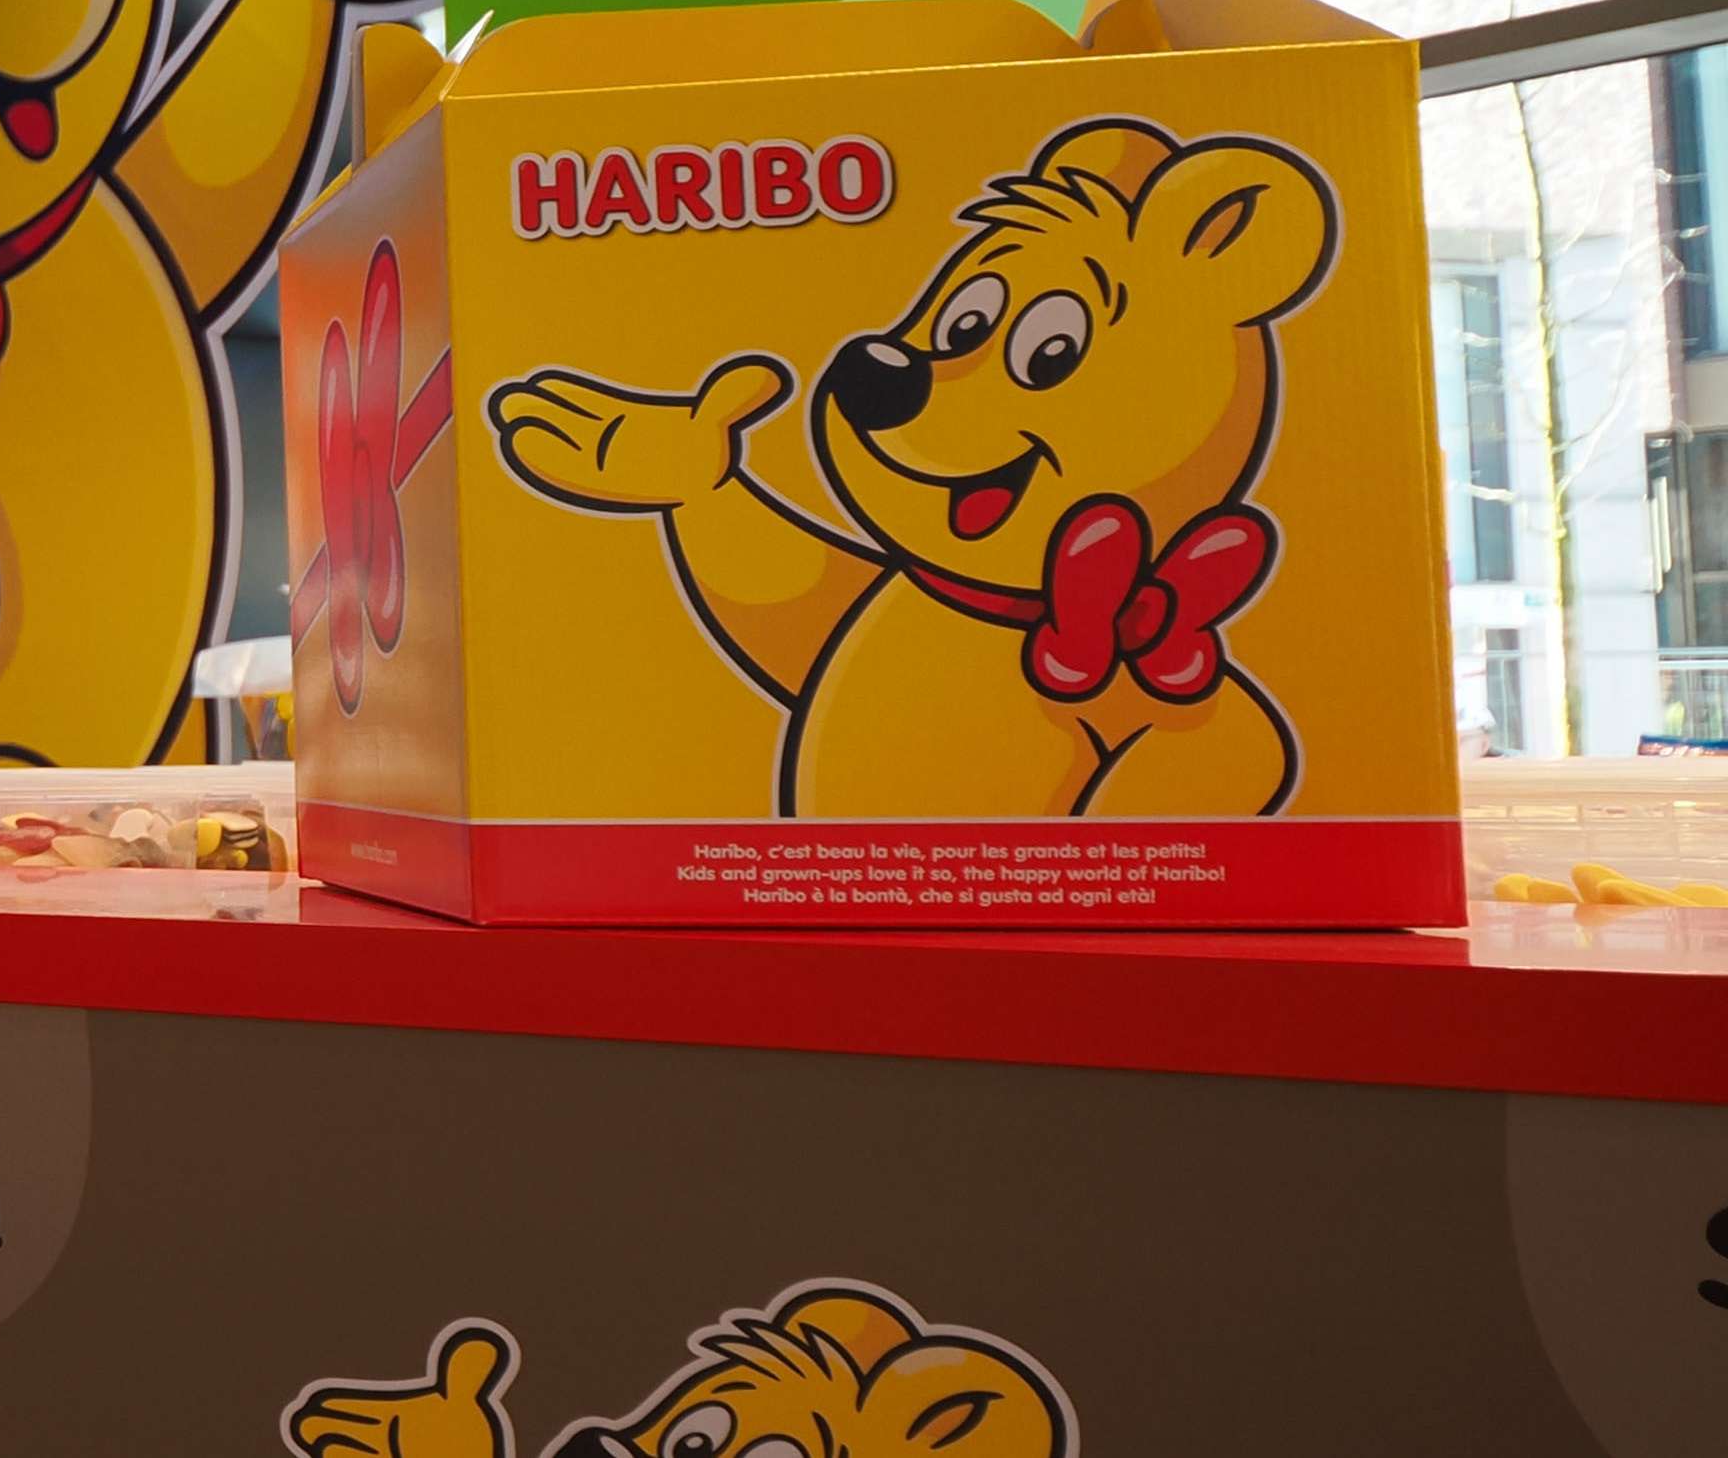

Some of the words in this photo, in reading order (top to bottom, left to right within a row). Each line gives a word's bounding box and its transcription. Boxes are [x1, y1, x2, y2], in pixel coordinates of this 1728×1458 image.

[516, 140, 886, 233] HARIBO
[694, 844, 762, 861] Haribo,
[817, 844, 865, 859] beau
[871, 843, 888, 859] la
[893, 844, 925, 861] vie,
[932, 847, 976, 862] pour
[982, 843, 1008, 859] les
[1015, 843, 1081, 862] grands
[1087, 844, 1106, 859] et
[1112, 843, 1139, 859] les
[1146, 843, 1206, 862] petits!
[677, 866, 716, 881] Kids
[721, 866, 757, 881] and
[762, 868, 863, 884] grown-ups
[868, 866, 907, 881] love
[912, 866, 925, 881] it
[930, 869, 957, 883] so,
[964, 866, 994, 881] the
[1000, 866, 1062, 884] happy
[1067, 866, 1121, 881] world
[1127, 866, 1148, 881] of
[1153, 866, 1225, 882] Haribo!
[744, 888, 806, 903] Haribo
[812, 888, 824, 903] è
[830, 888, 847, 903] la
[852, 888, 913, 906] bontà,
[919, 888, 953, 903] che
[959, 888, 973, 903] si
[978, 889, 1032, 907] gusta
[1039, 888, 1064, 903] ad
[1070, 888, 1111, 907] ogni
[1117, 888, 1156, 903] età!
